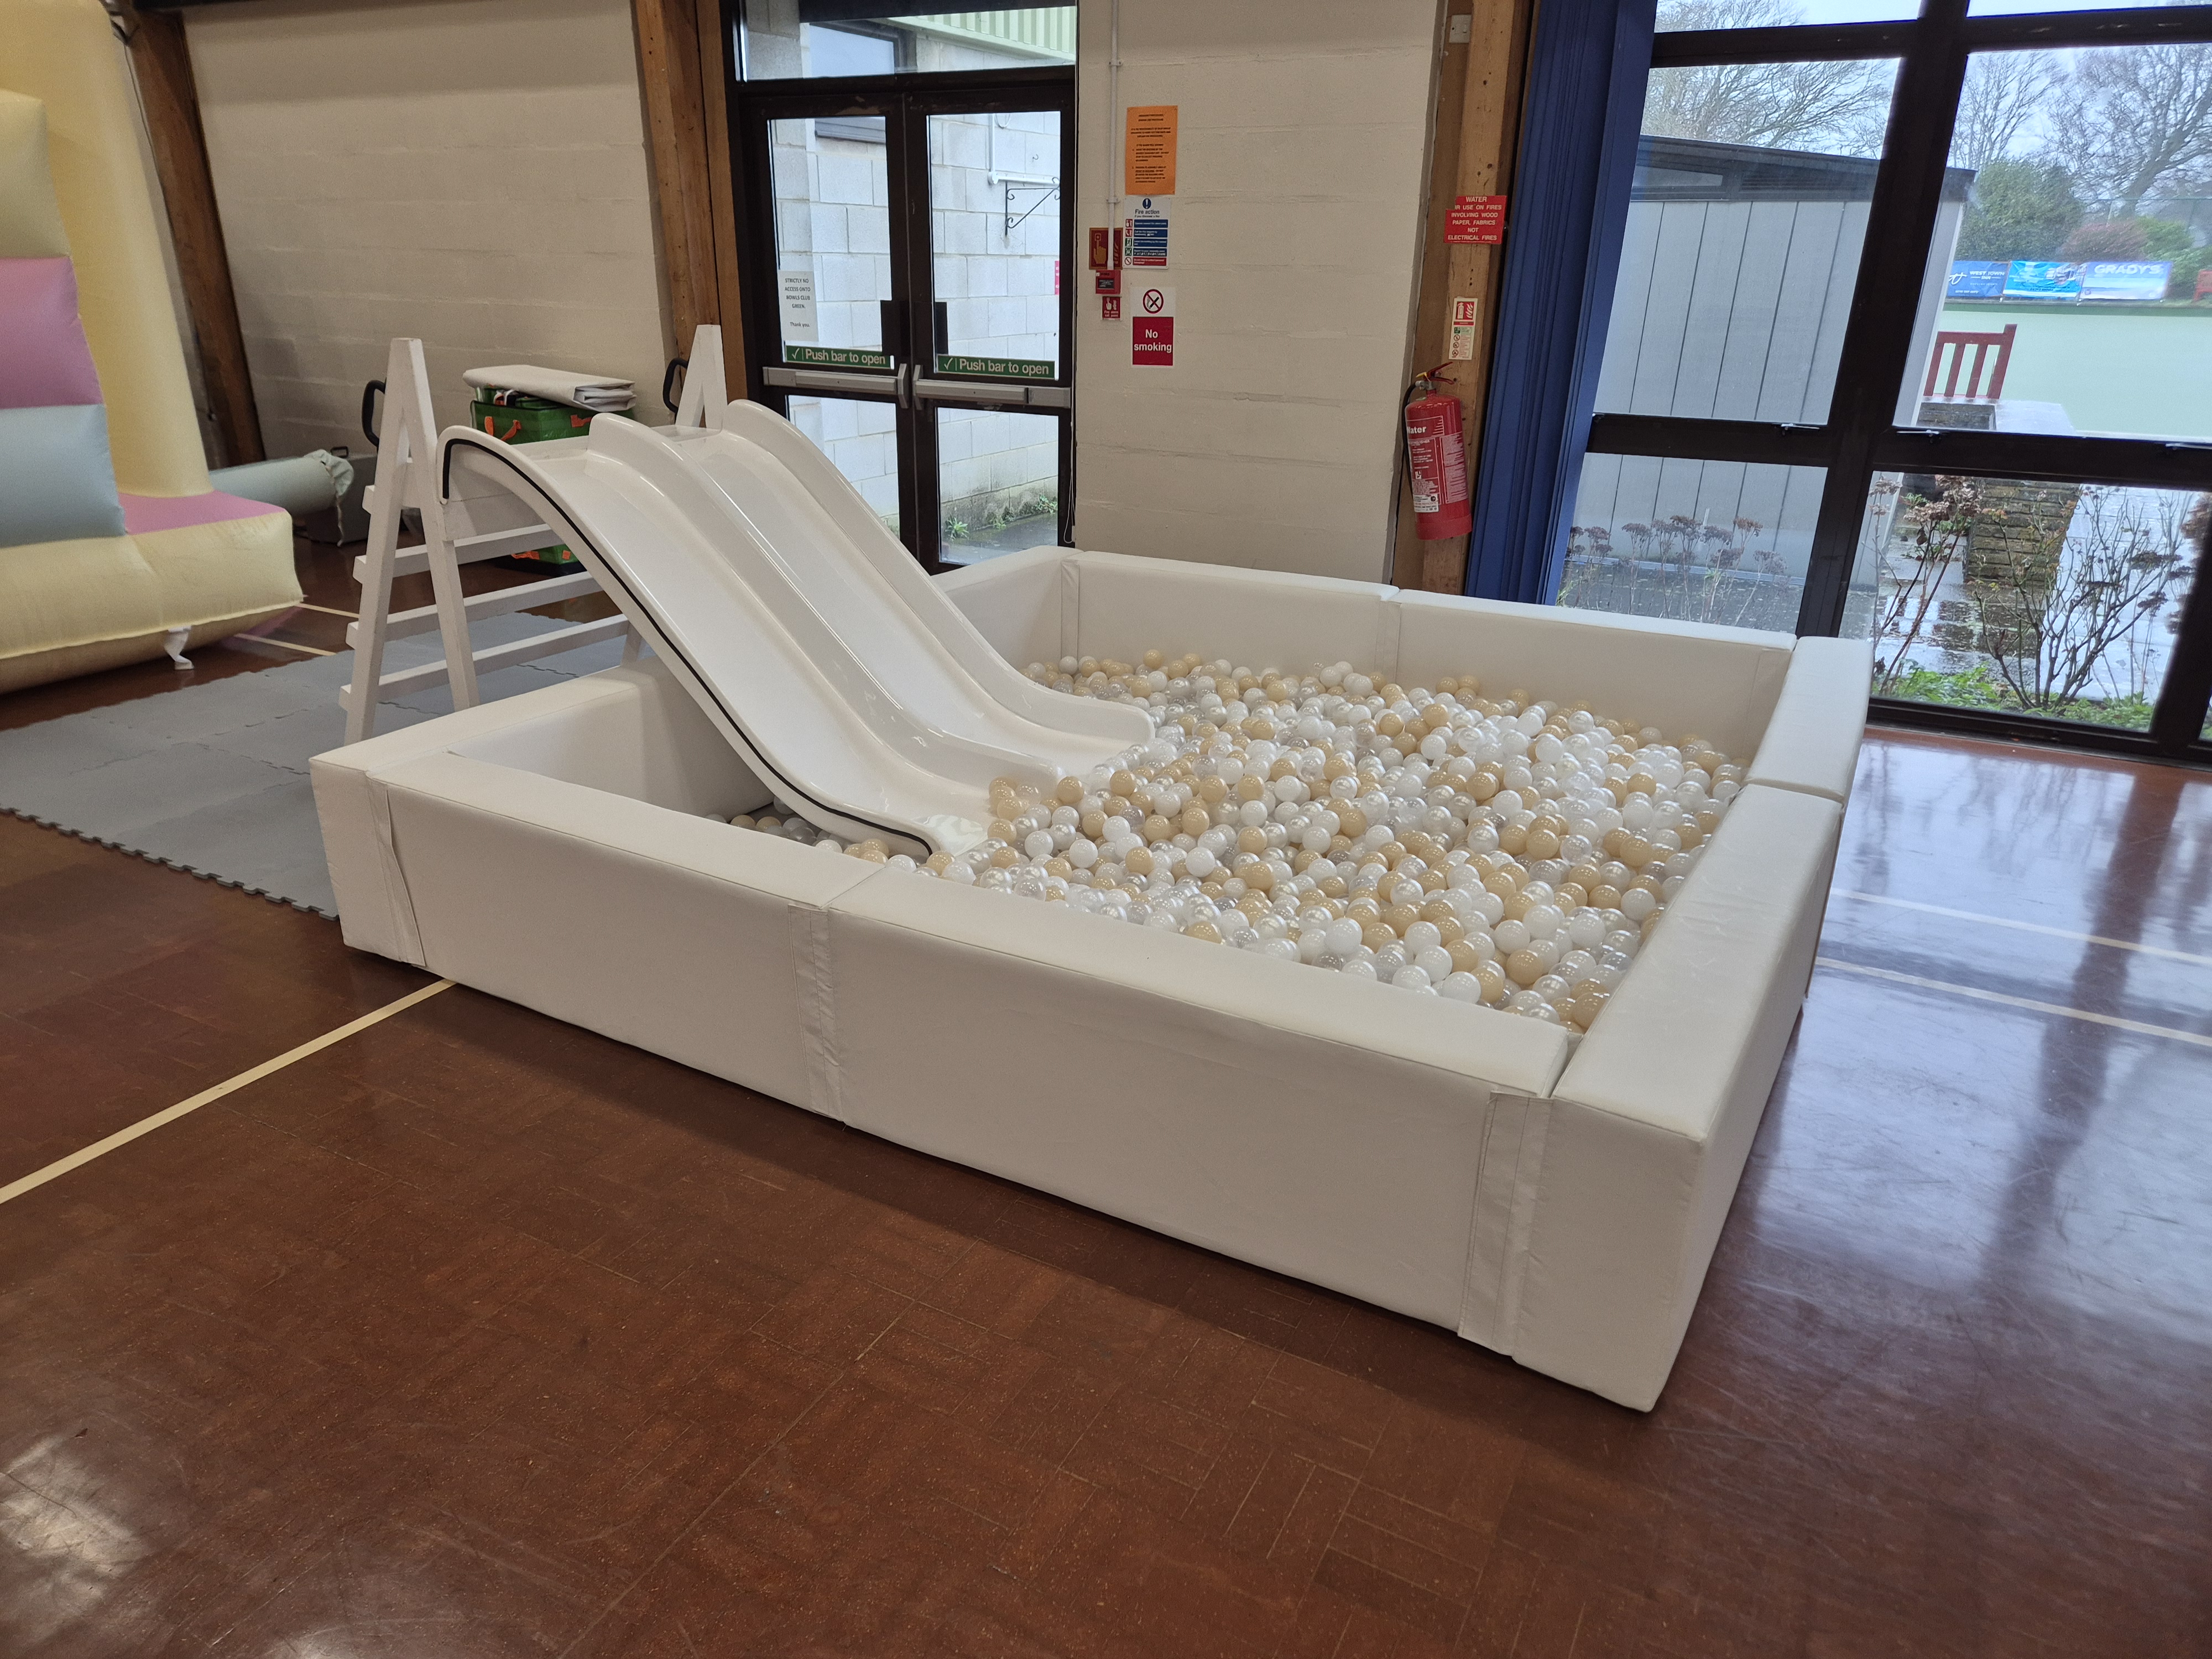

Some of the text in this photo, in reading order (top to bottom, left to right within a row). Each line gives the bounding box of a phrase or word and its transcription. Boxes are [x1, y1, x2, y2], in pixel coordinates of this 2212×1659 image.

[2094, 264, 2161, 274] GRADY'S
[1145, 328, 1158, 338] No
[1134, 342, 1172, 353] smoking
[805, 348, 885, 366] Push bar to open
[959, 358, 1049, 377] Push bar to open
